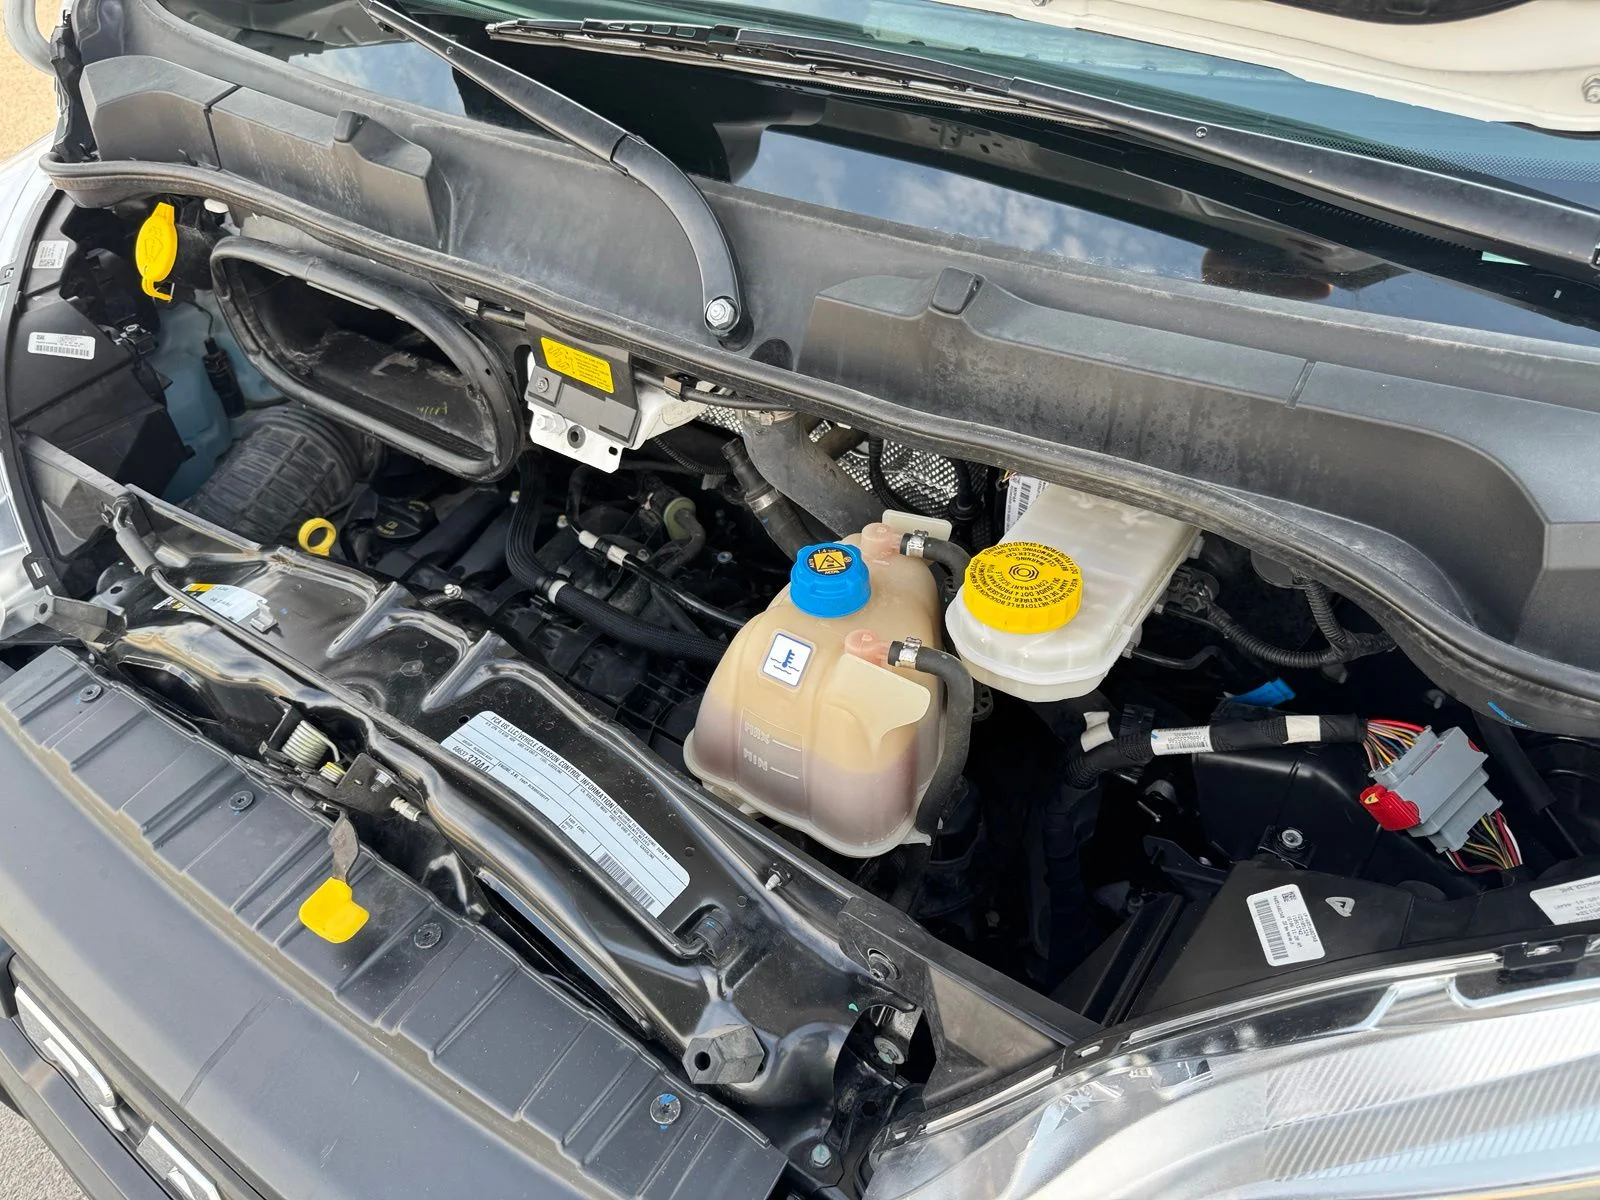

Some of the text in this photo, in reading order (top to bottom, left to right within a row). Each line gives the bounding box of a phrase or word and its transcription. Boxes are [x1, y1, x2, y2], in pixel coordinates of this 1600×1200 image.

[1011, 580, 1048, 590] CONTENANT
[491, 716, 502, 724] FCA
[508, 727, 518, 735] LLC
[743, 748, 769, 771] MIN
[519, 734, 538, 748] VEHICLE
[537, 746, 559, 762] EMISSION
[559, 761, 580, 780] CONTROL
[579, 779, 614, 808] INFORMATION
